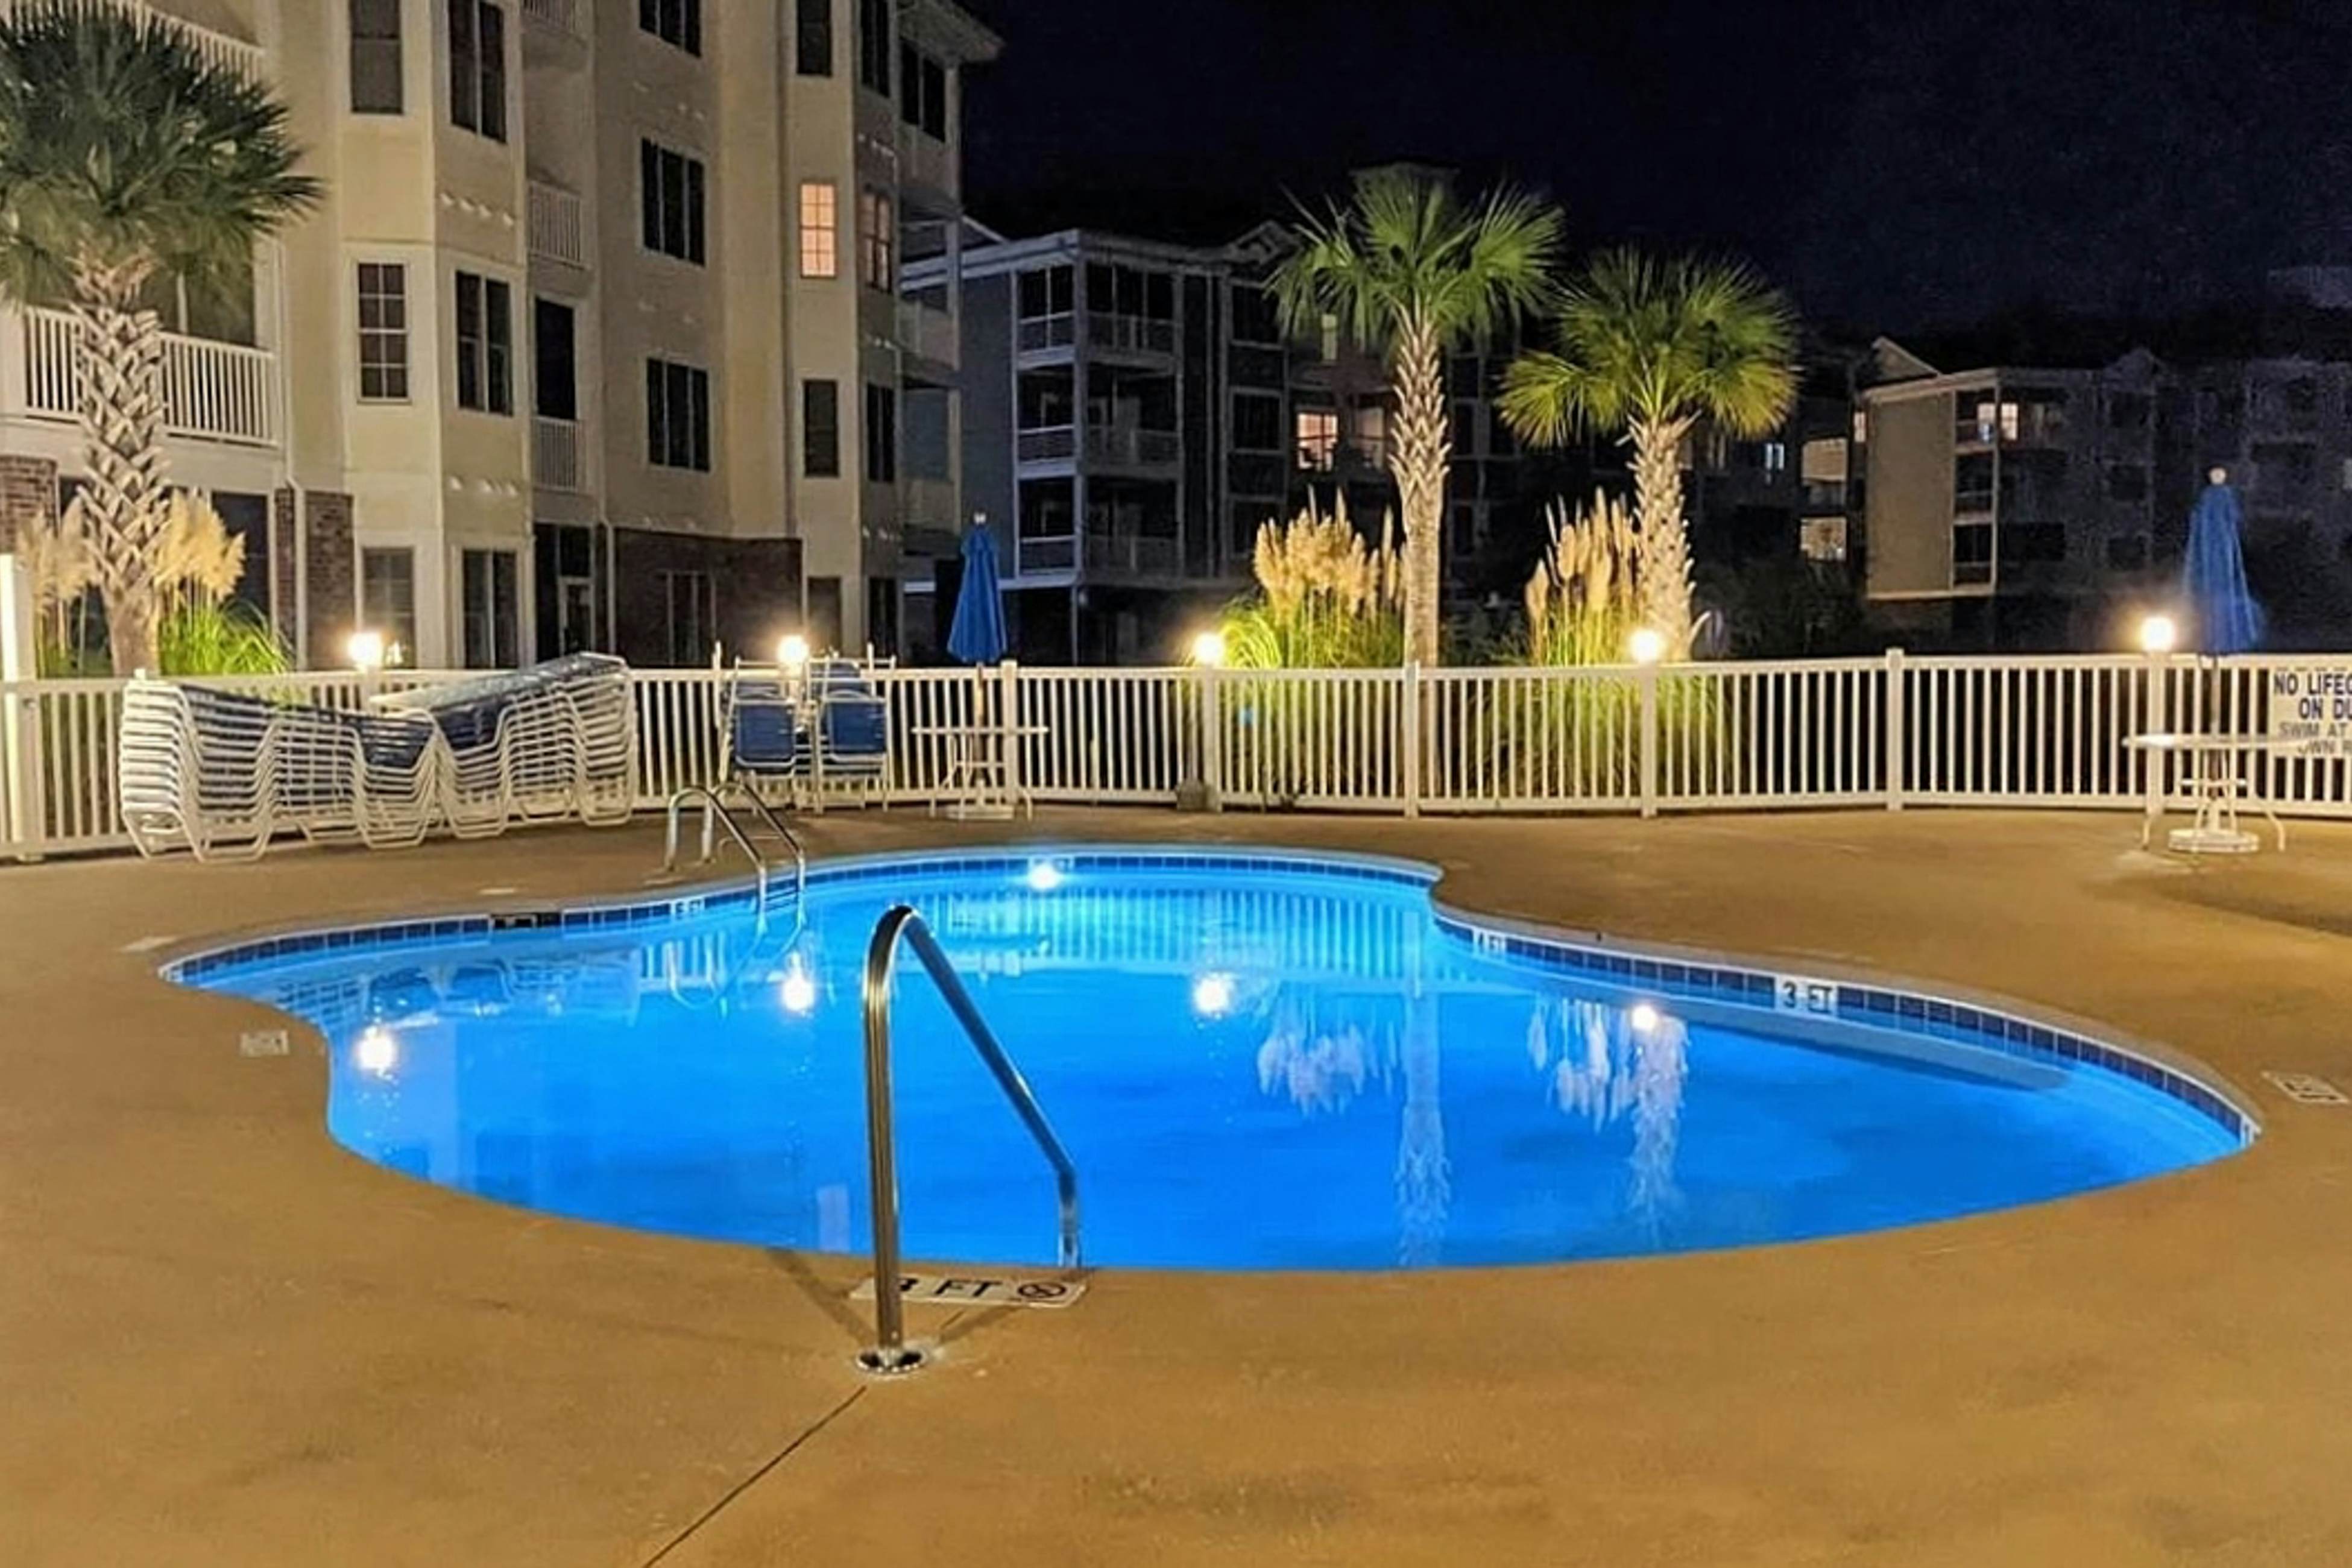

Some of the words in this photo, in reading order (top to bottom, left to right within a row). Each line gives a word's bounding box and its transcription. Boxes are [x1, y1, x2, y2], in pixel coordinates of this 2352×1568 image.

[2274, 673, 2298, 695] NO
[2299, 697, 2323, 720] ON
[2327, 722, 2347, 737] AT
[1783, 981, 1797, 1009] 3
[935, 1279, 1003, 1297] FT
